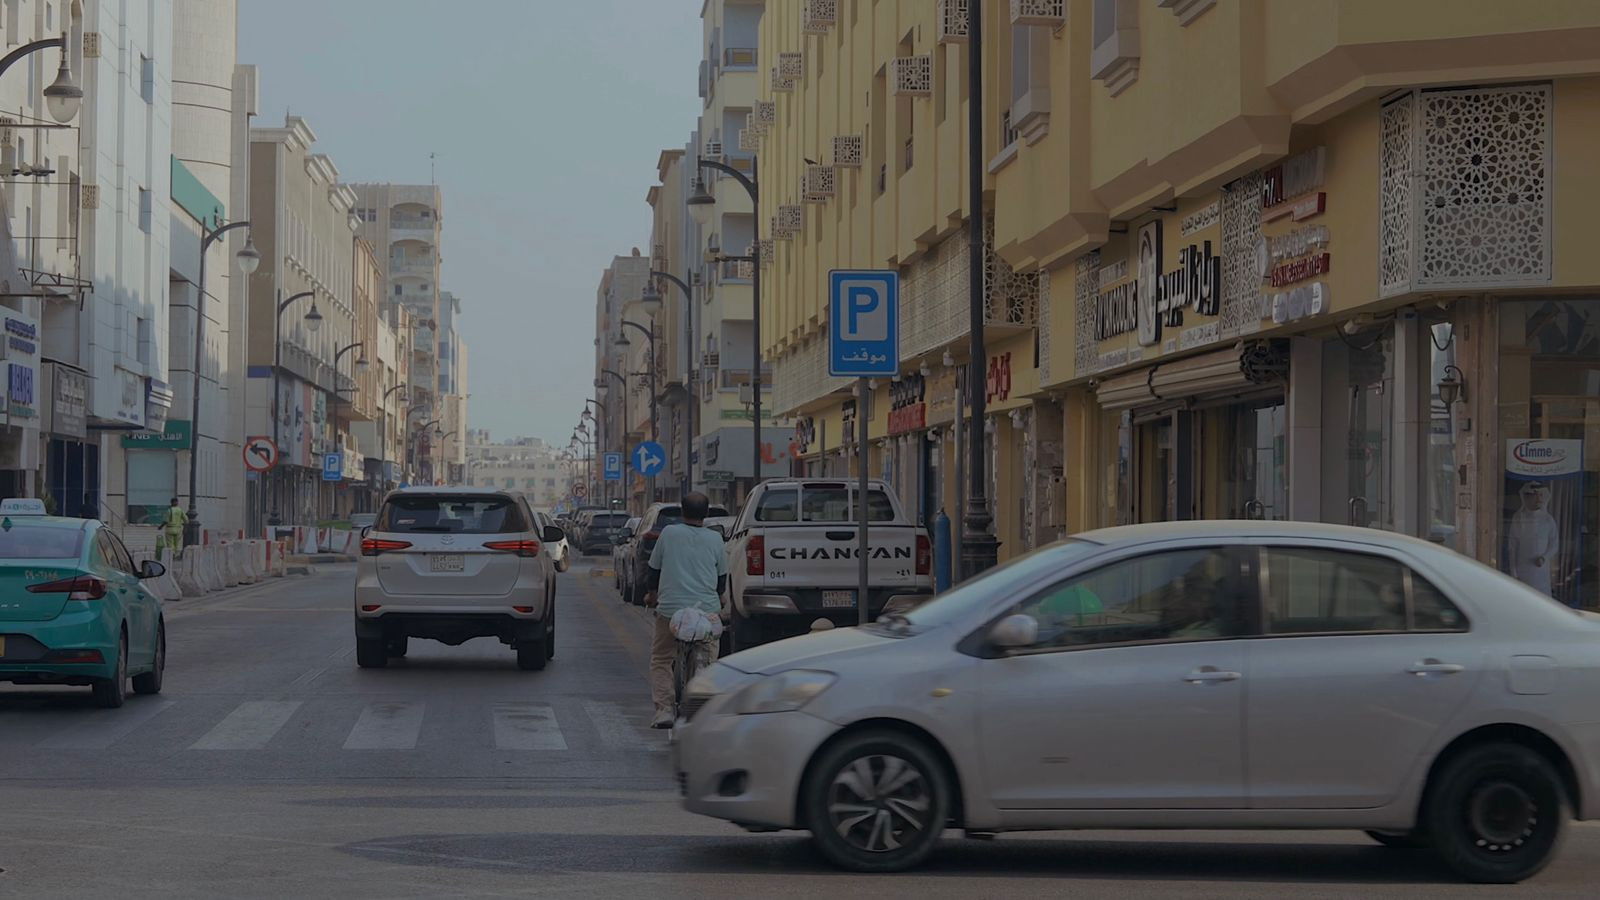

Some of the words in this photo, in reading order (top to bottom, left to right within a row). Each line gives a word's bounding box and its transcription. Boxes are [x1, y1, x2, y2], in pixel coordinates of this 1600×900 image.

[849, 286, 879, 334] P
[841, 347, 887, 364] موقف
[328, 456, 336, 470] P
[608, 456, 617, 470] P
[770, 571, 785, 579] 041
